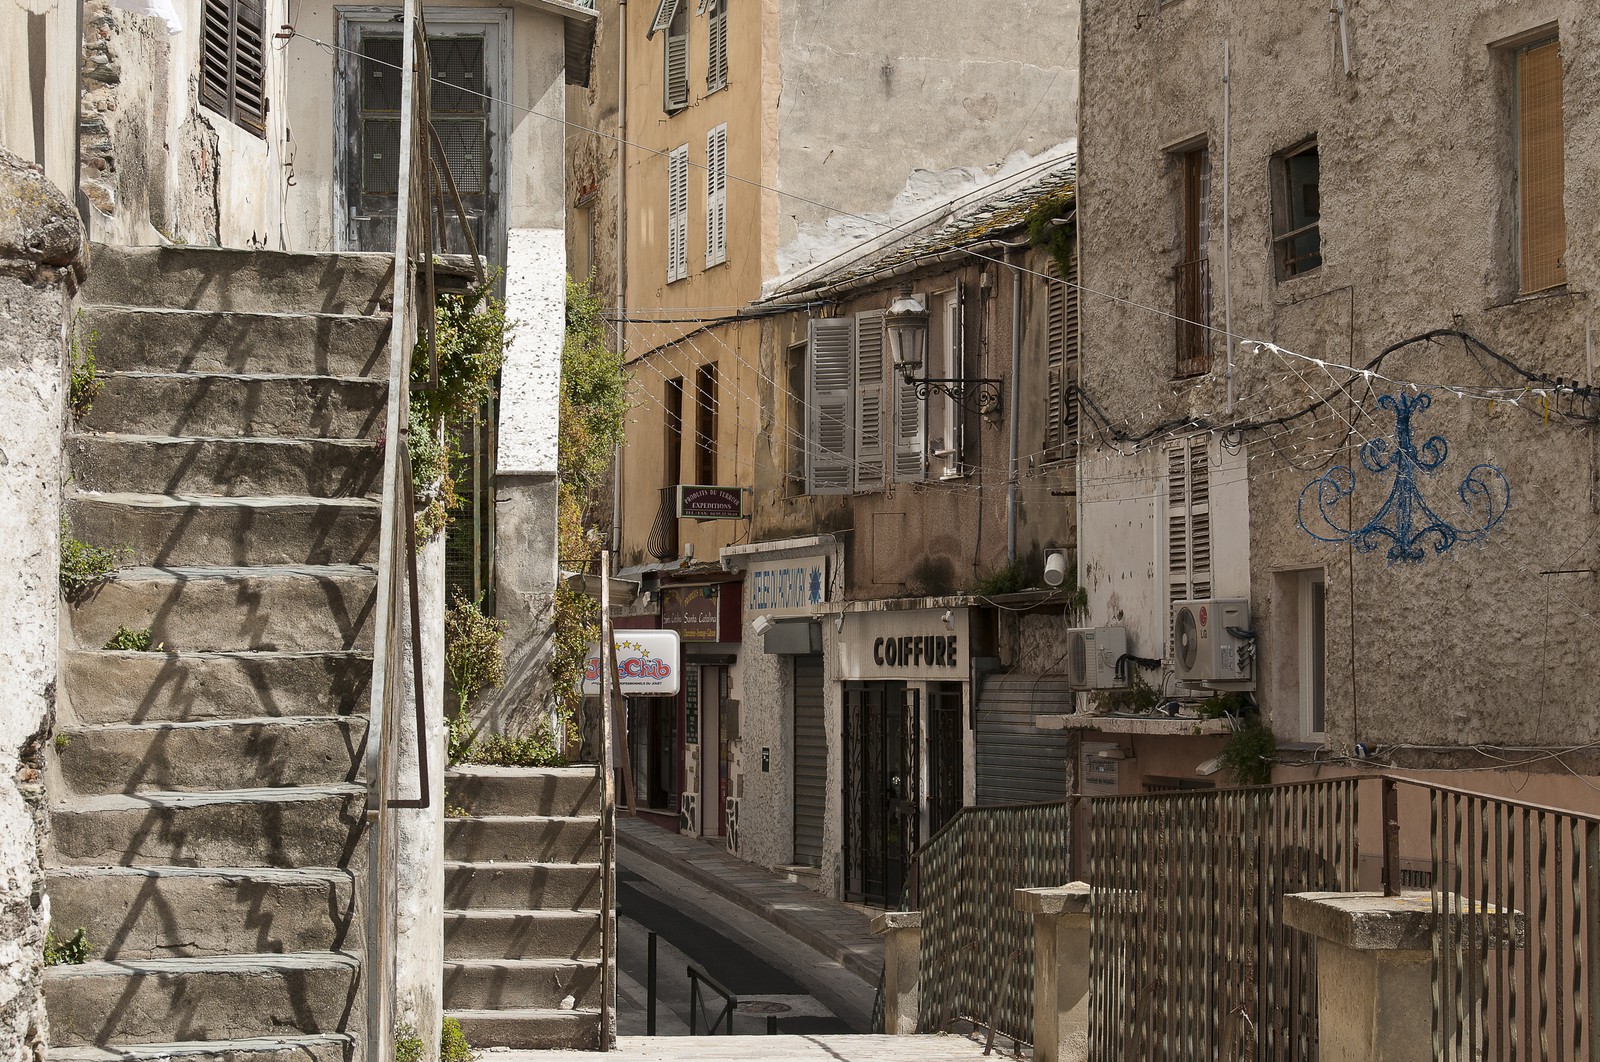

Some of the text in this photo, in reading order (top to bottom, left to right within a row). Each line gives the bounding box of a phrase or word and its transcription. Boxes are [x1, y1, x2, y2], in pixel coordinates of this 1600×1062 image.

[684, 489, 708, 505] PRODUITS
[719, 490, 740, 506] TERROIR
[683, 611, 717, 624] Santa Catalina
[1200, 629, 1208, 639] LG
[873, 635, 957, 667] COIFFURE
